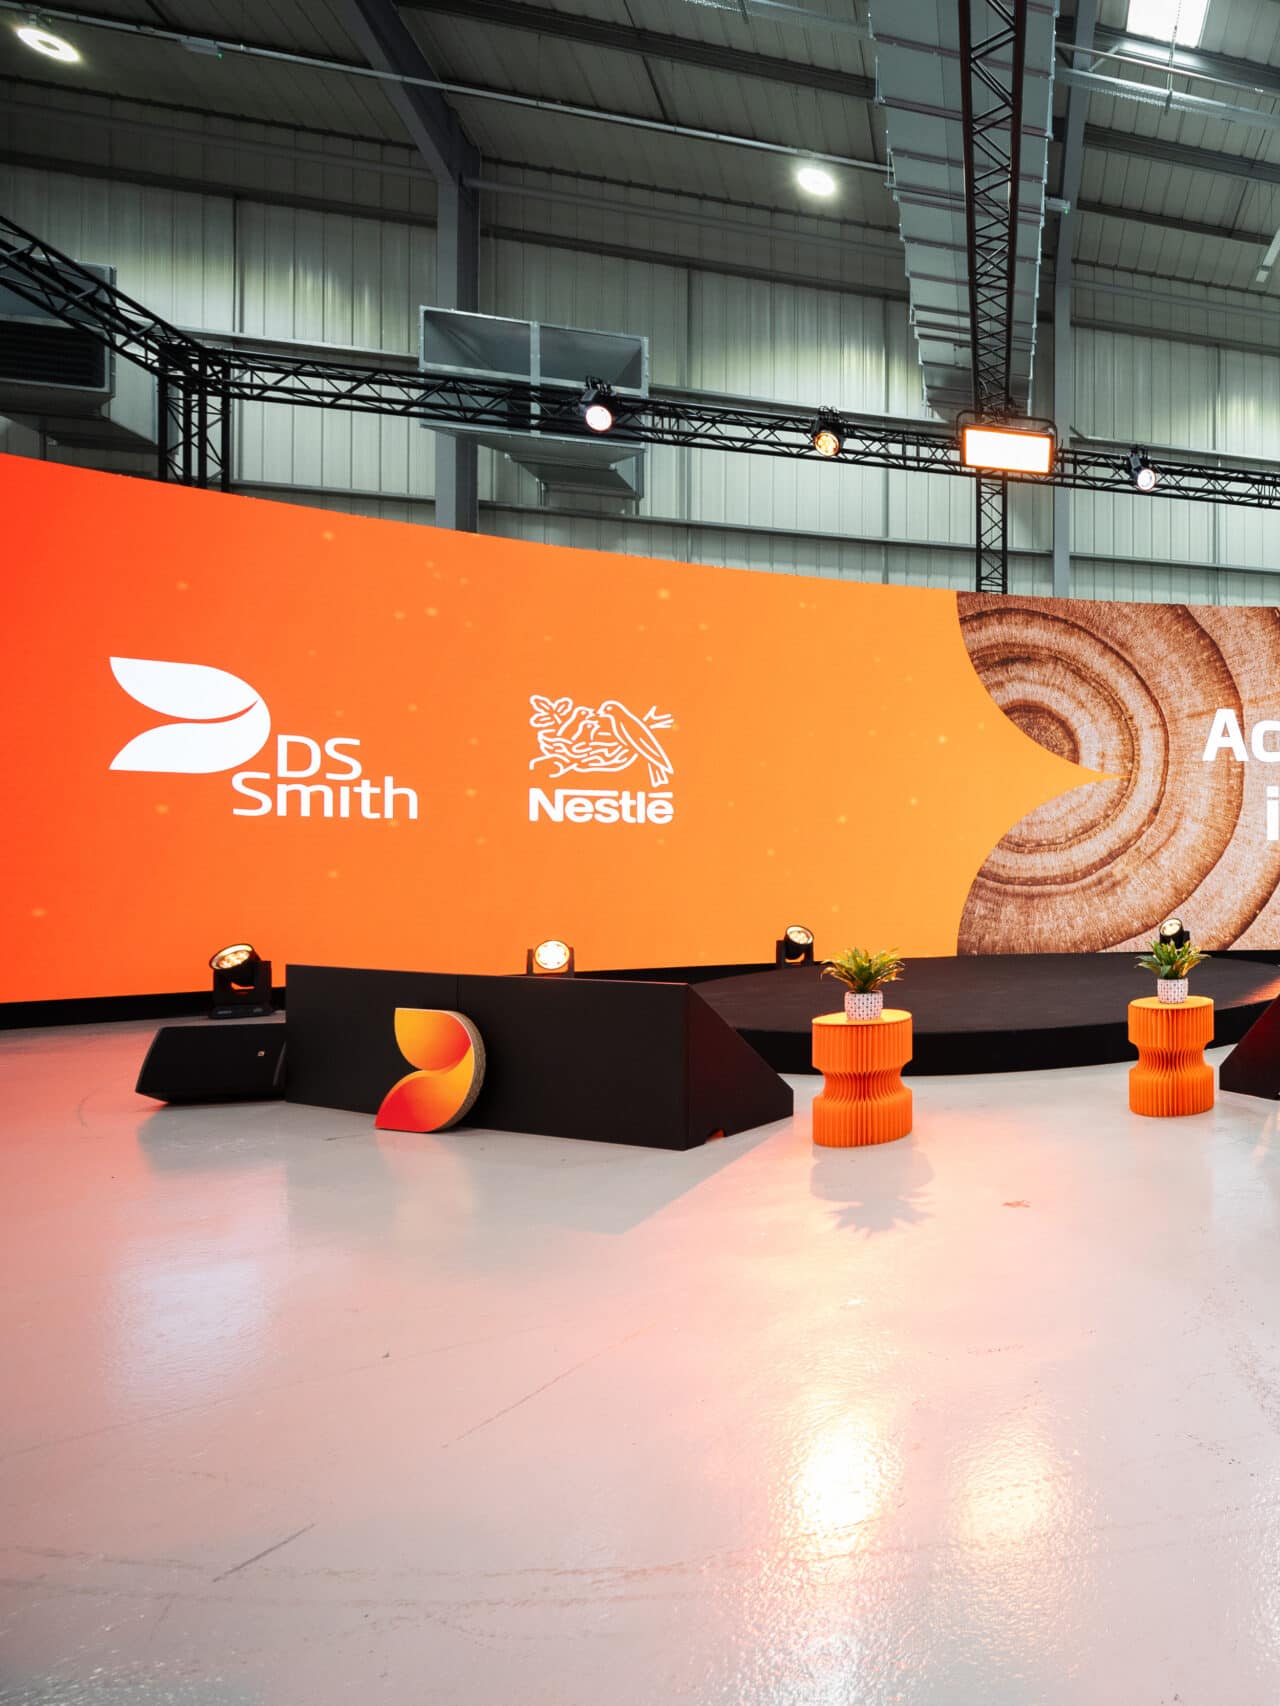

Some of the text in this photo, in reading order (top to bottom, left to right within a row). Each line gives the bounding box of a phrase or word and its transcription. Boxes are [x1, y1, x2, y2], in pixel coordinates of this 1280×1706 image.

[277, 734, 362, 781] DS
[231, 771, 418, 820] Smith
[529, 788, 674, 824] Nestlé
